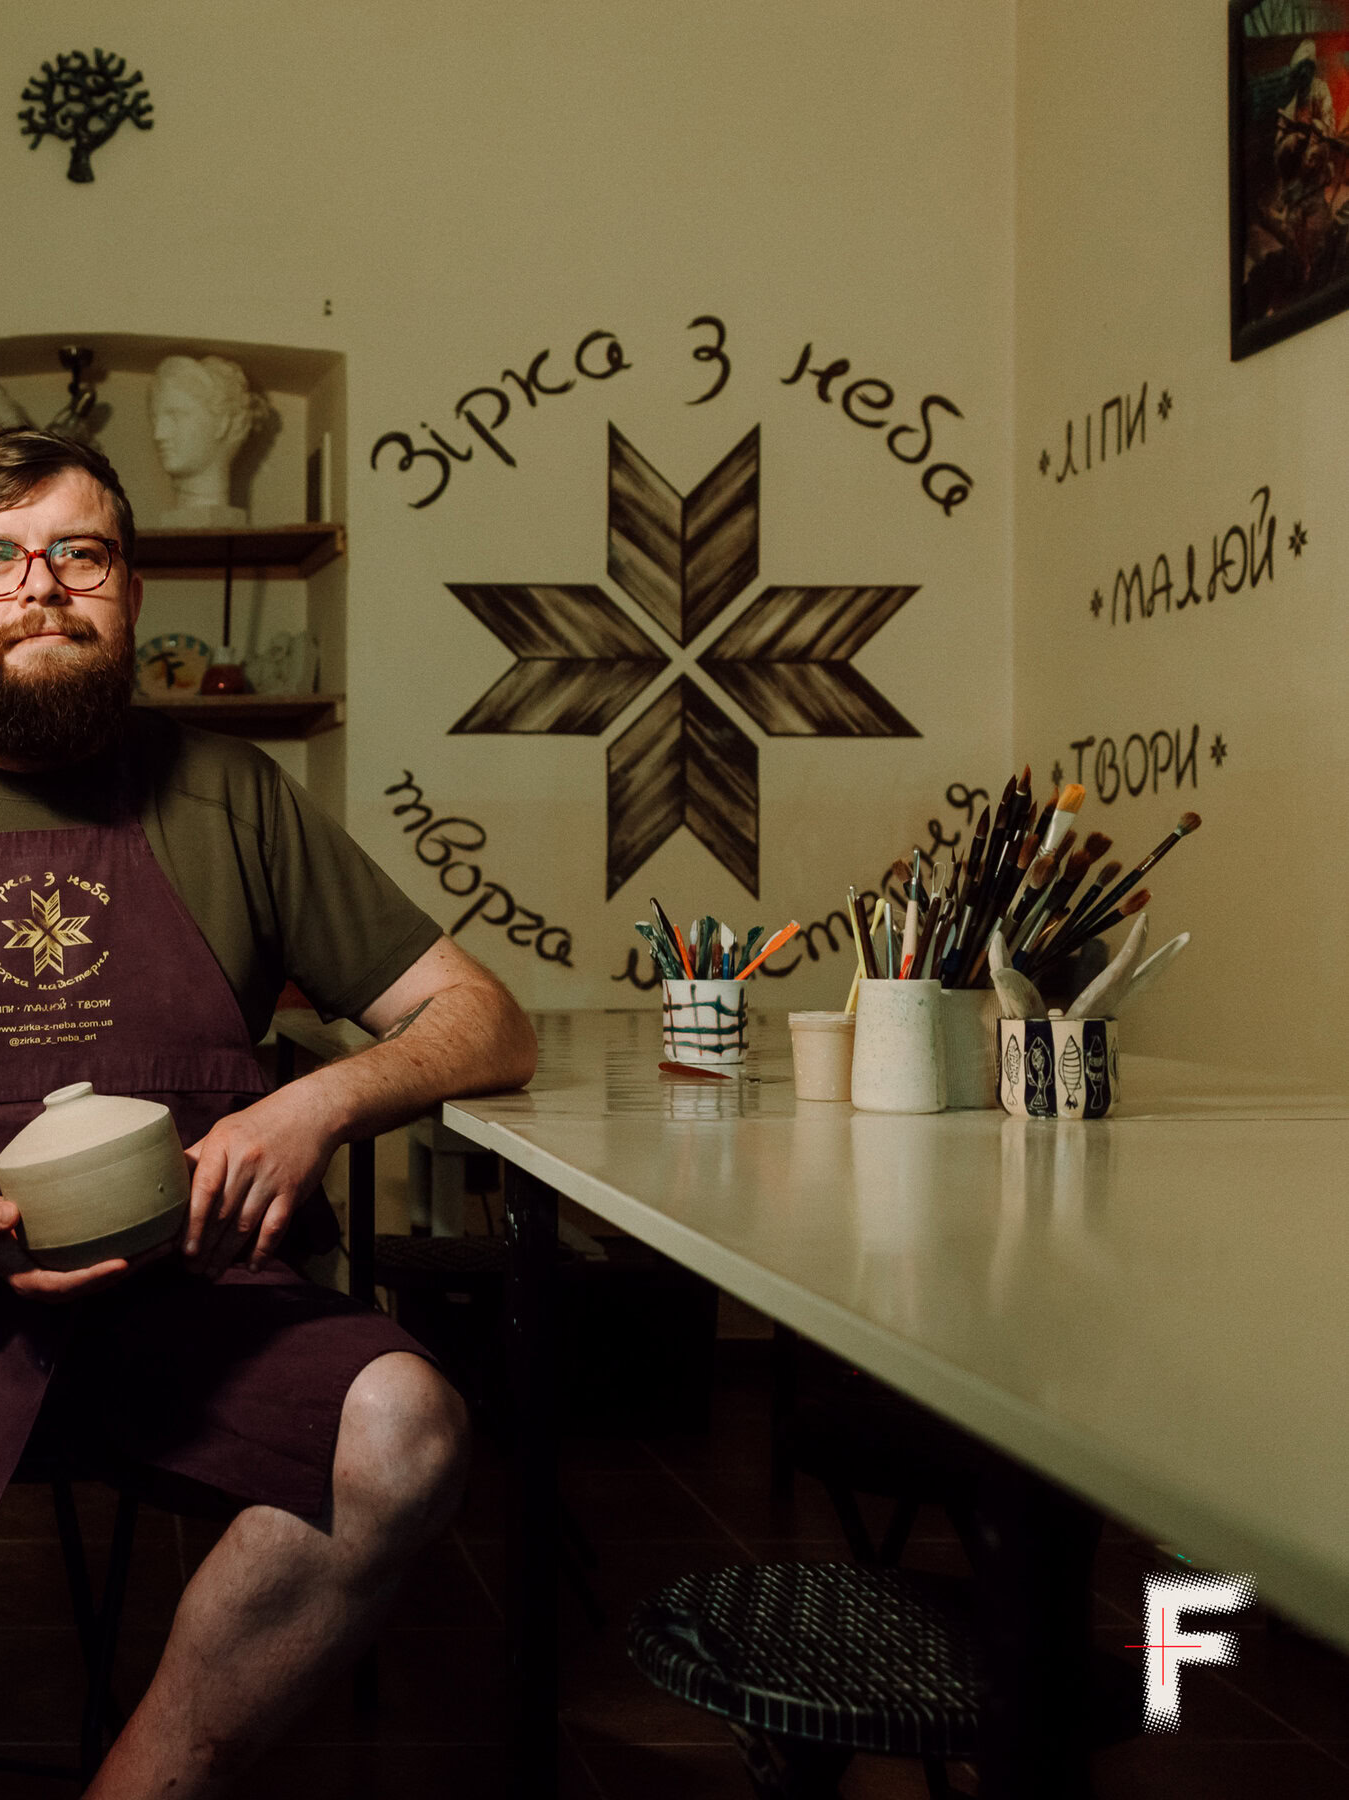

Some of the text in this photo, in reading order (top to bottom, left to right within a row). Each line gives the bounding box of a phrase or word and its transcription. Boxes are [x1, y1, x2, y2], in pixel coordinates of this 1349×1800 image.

[370, 330, 632, 509] Зірка
[781, 342, 973, 517] неба
[1056, 381, 1148, 483] ЛІПИ
[1111, 485, 1277, 626] МАЛЮЙ
[1070, 724, 1199, 804] ТВОРИ
[67, 874, 110, 906] неба
[384, 770, 575, 969] творча
[23, 997, 67, 1012] МАЛЮЙ
[77, 999, 111, 1010] ТВОРИ
[37, 950, 110, 990] майстерня
[9, 1033, 97, 1047] @zirka_z_neba_art
